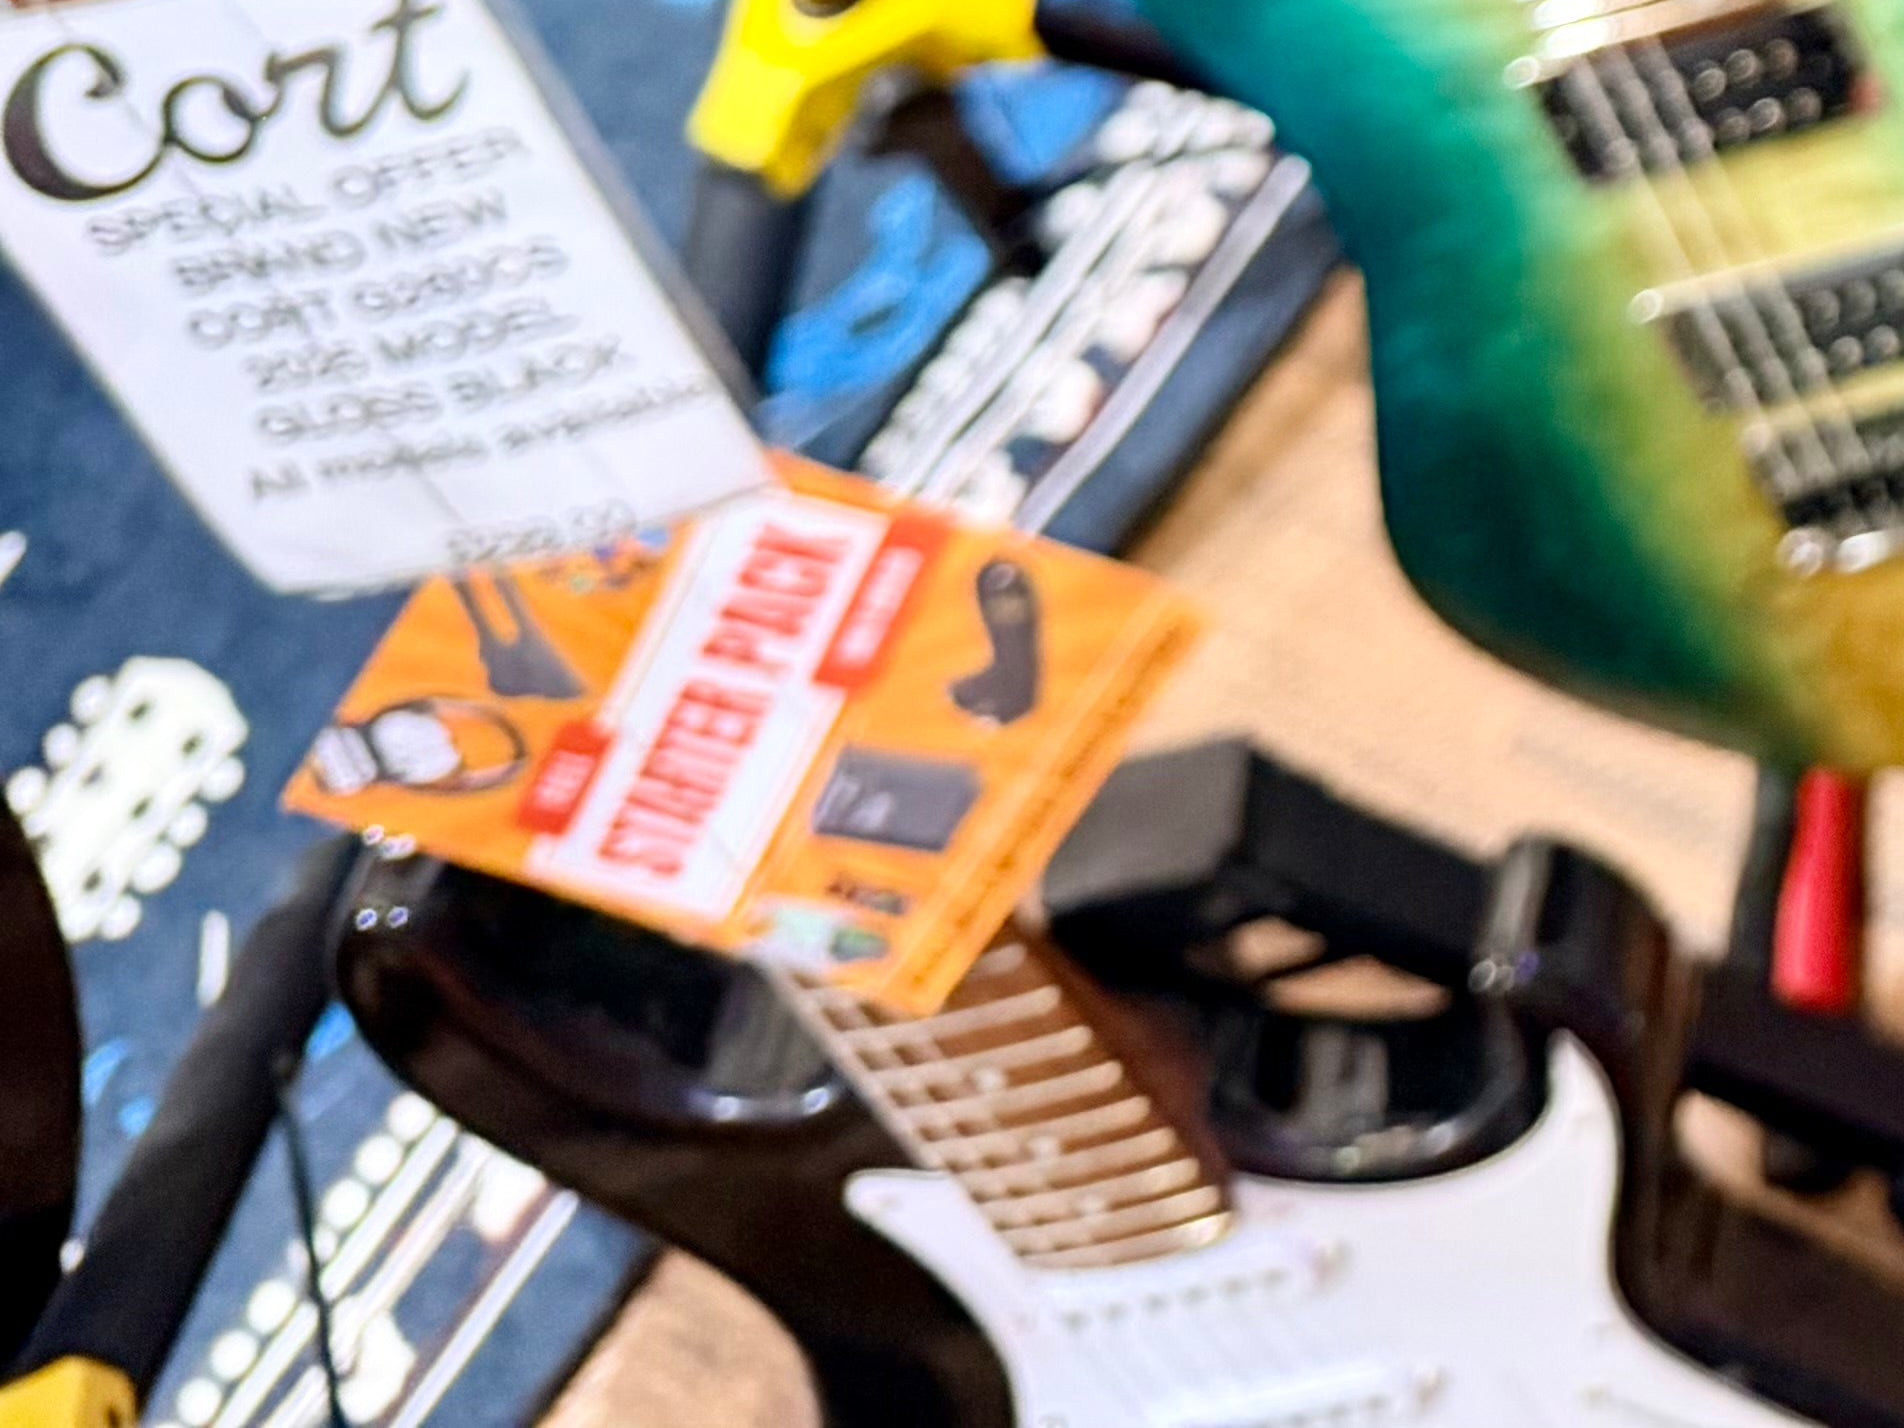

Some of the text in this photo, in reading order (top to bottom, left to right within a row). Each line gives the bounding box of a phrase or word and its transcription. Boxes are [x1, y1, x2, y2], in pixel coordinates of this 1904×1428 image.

[86, 128, 530, 256] SPECIAL OFFER
[174, 190, 508, 294] BRAND NEW
[598, 522, 852, 877] STARTER PACK
